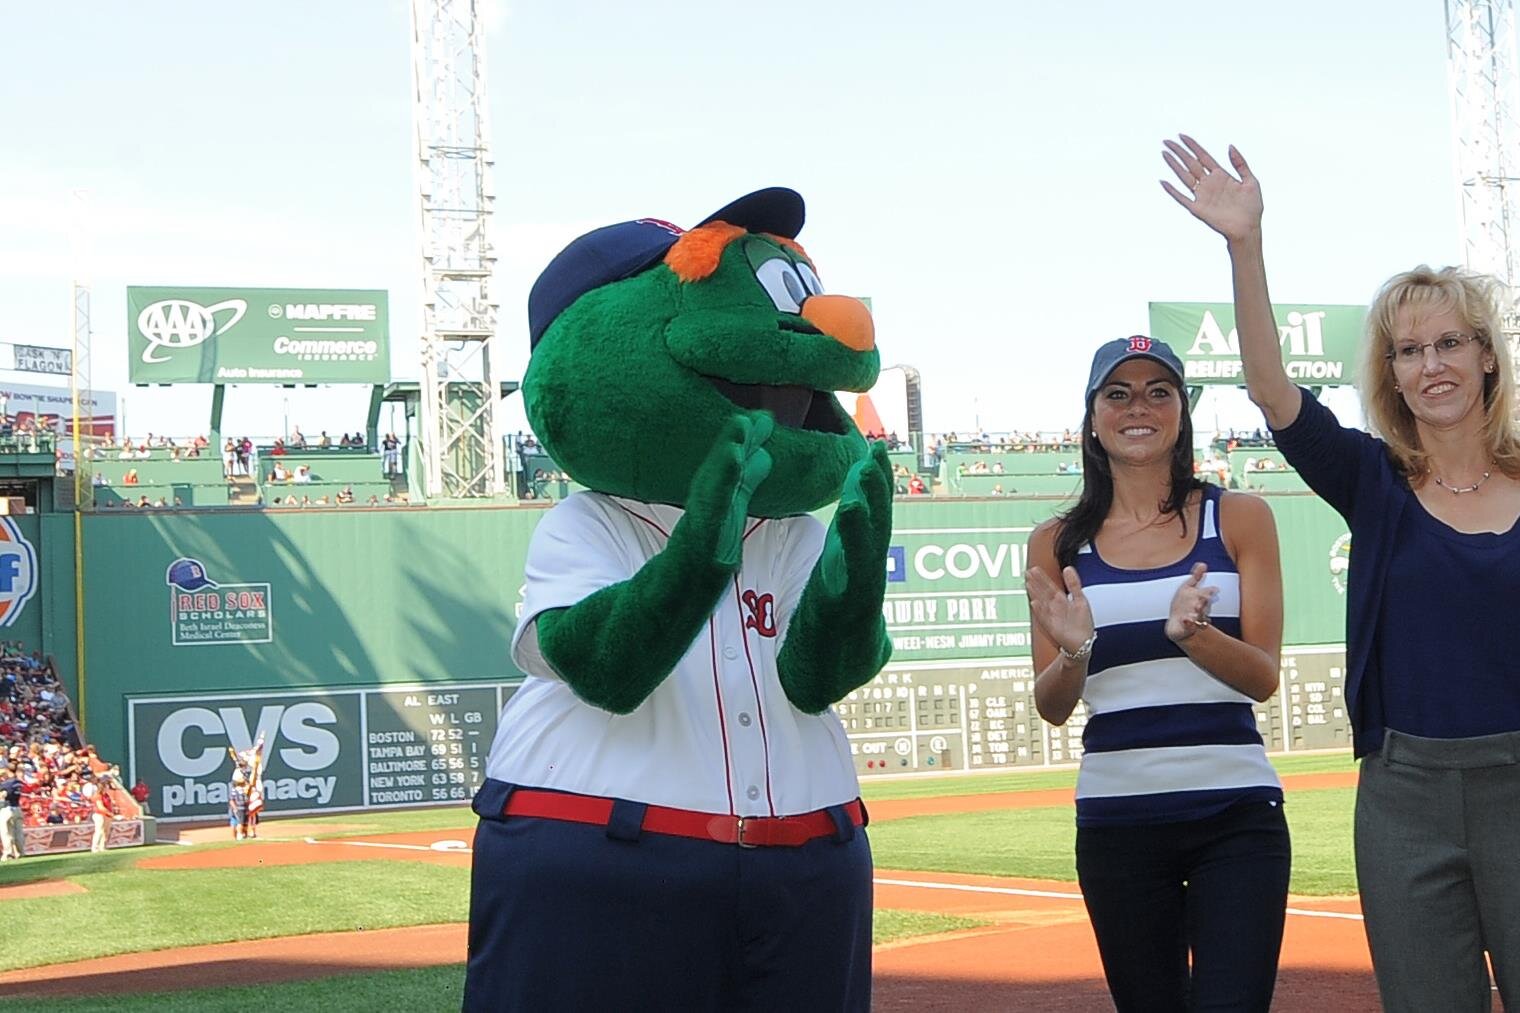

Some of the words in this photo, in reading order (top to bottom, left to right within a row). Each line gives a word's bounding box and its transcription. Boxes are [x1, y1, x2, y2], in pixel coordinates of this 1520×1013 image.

[285, 304, 376, 321] MAPFRE
[147, 304, 206, 343] AAA
[1186, 310, 1326, 356] Ail
[273, 337, 377, 355] Commerce
[1126, 337, 1152, 353] B
[217, 367, 247, 378] Auto
[249, 367, 303, 378] Insurance
[1185, 360, 1243, 378] RELIEF
[1286, 361, 1344, 379] CTION
[914, 543, 1028, 580] COVI
[179, 593, 220, 612] RED
[225, 591, 266, 610] SOX
[946, 597, 998, 621] PARK
[179, 610, 266, 620] SCHOLARS
[180, 623, 198, 632] Beth
[200, 622, 222, 631] Israel
[224, 621, 266, 630] Deaconess
[180, 631, 213, 639] Medical
[959, 634, 995, 648] JIMMY
[996, 633, 1025, 647] FUND
[404, 695, 421, 706] AL
[428, 694, 459, 706] EAST
[429, 713, 445, 724] W
[450, 713, 460, 723] L
[464, 712, 482, 723] GB
[157, 703, 340, 777] CVS
[369, 731, 414, 743] BOSTON
[431, 730, 446, 741] 72
[448, 729, 463, 740] 52
[370, 747, 404, 758] TAMPA
[406, 746, 425, 756] BAY
[431, 745, 446, 755] 69
[450, 744, 463, 754] 51
[862, 742, 887, 754] OUT
[370, 760, 427, 773] BALTIMORE
[431, 759, 447, 770] 65
[449, 758, 464, 769] 56
[470, 757, 479, 767] 5
[370, 777, 394, 788] NEW
[397, 775, 426, 786] YORK
[432, 774, 447, 785] 63
[450, 773, 465, 783] 58
[471, 772, 479, 782] 7
[163, 776, 336, 813] phaacy
[371, 790, 423, 803] TORONTO
[432, 789, 448, 799] 56
[450, 787, 465, 798] 66
